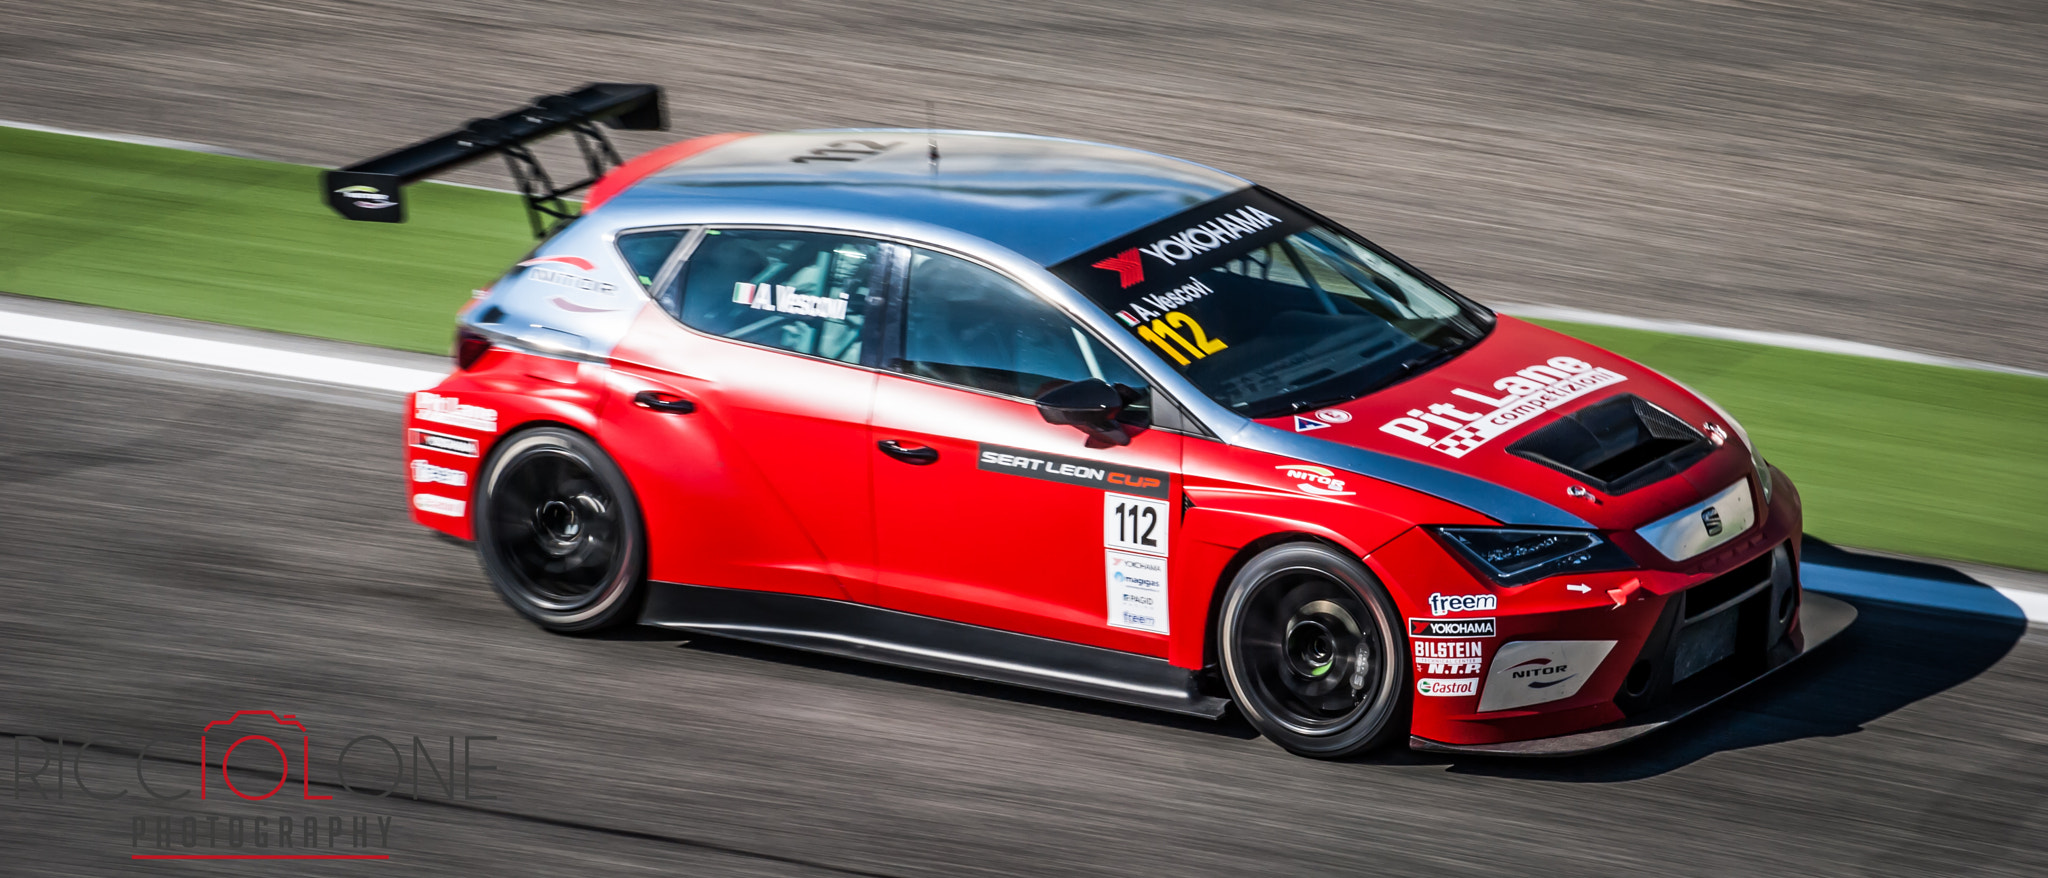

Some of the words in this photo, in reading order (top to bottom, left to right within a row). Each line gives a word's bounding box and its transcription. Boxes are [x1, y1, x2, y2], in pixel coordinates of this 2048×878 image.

[1138, 205, 1283, 266] YOKOHAMA
[1137, 311, 1228, 366] 112
[1378, 402, 1483, 448] Pit
[1450, 356, 1592, 407] Lane
[1490, 372, 1615, 426] competizioni
[980, 451, 1044, 471] SEAT
[1045, 461, 1105, 481] LEON
[1107, 472, 1161, 488] CUP
[1287, 469, 1345, 491] NITOR
[1115, 502, 1157, 547] 112
[1124, 560, 1161, 572] YOKOHAMA
[1431, 593, 1495, 614] freem
[1430, 623, 1493, 634] YOKOHAMA
[1415, 641, 1482, 657] BILSTEIN
[1512, 664, 1567, 679] NITOR
[1432, 681, 1472, 693] Castrol
